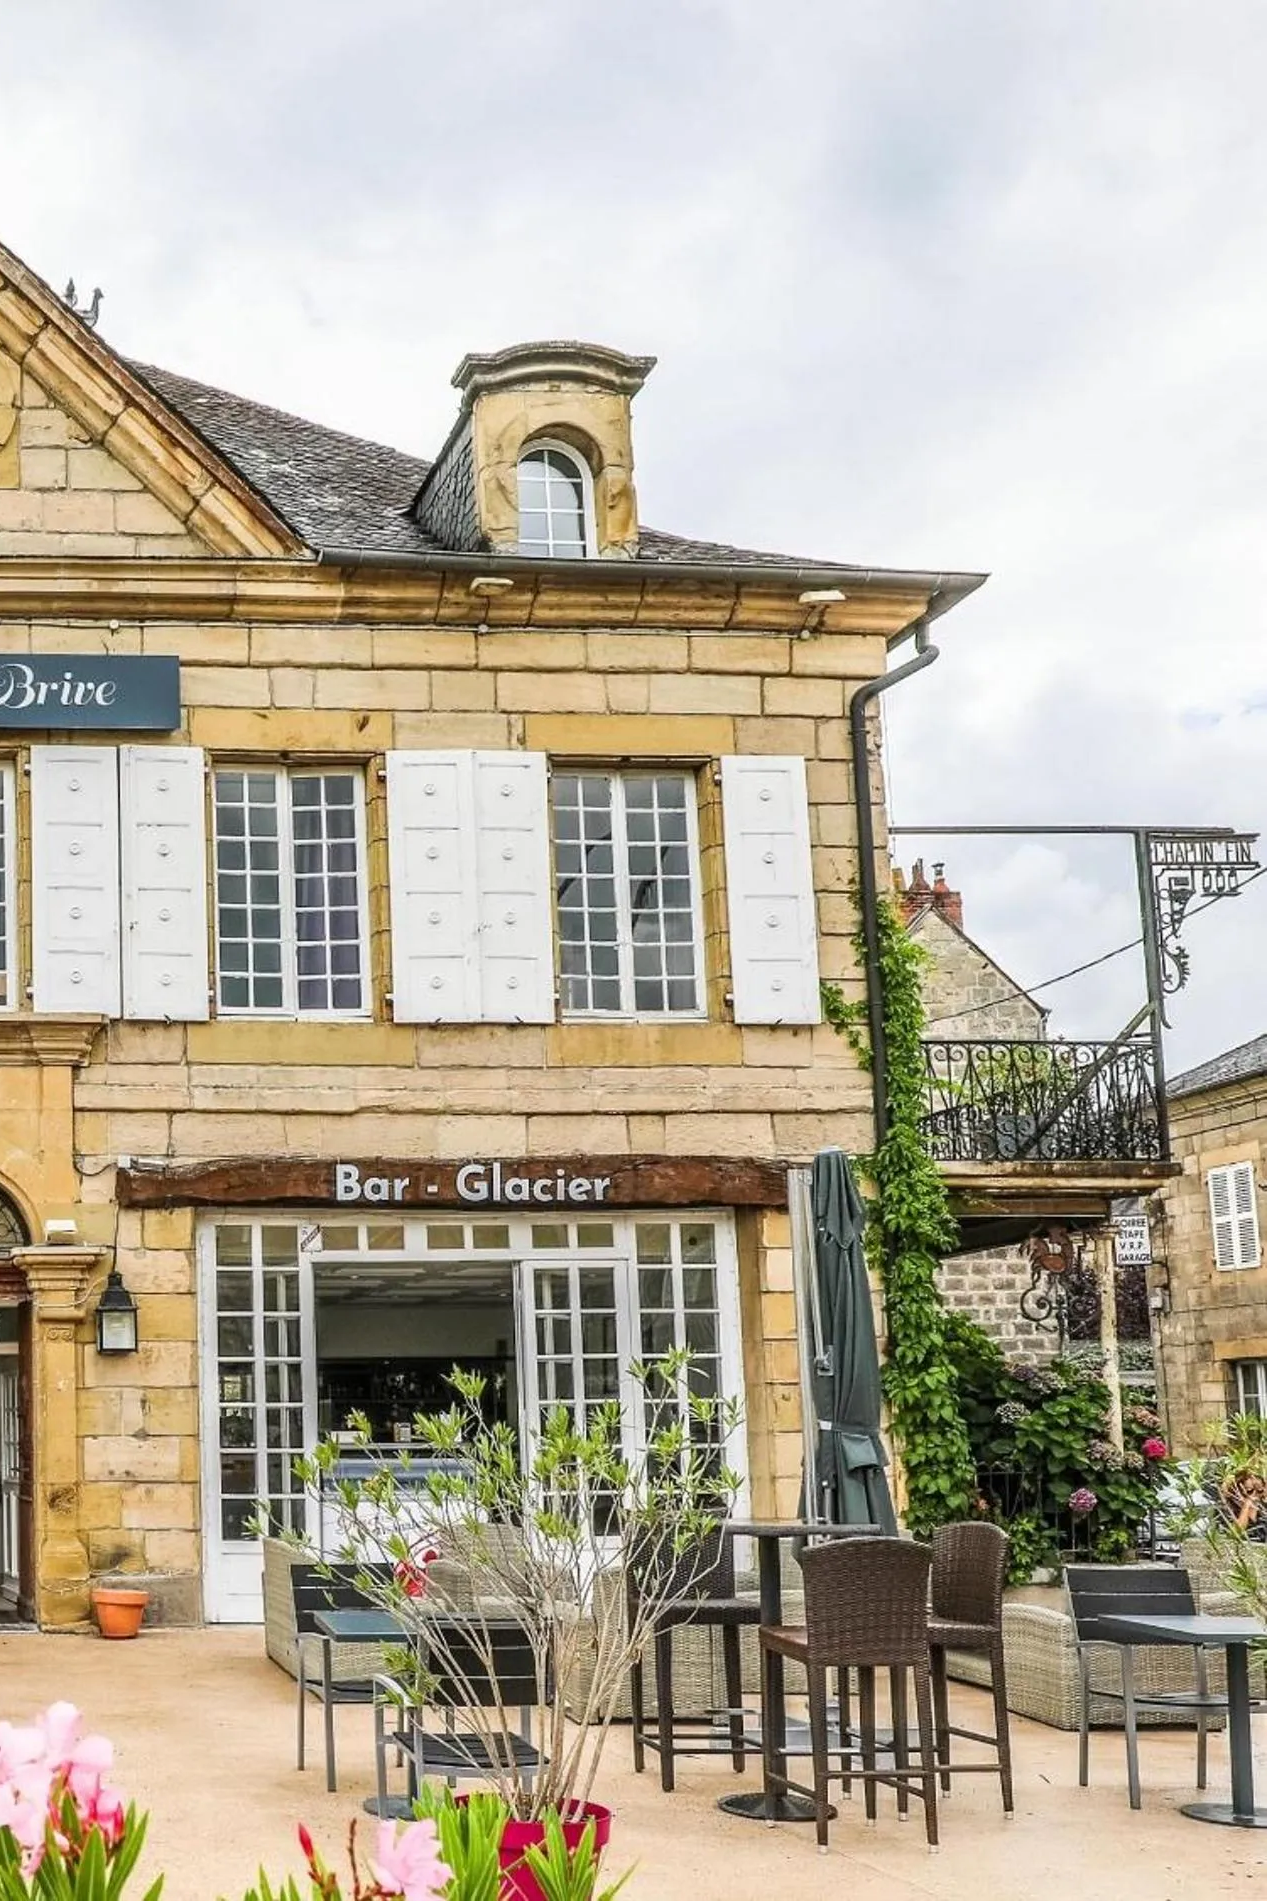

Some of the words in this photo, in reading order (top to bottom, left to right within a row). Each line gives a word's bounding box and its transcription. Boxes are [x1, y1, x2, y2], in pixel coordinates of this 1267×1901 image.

[1225, 840, 1251, 863] FIN
[335, 1163, 409, 1201] Bar
[456, 1162, 610, 1202] Glacier
